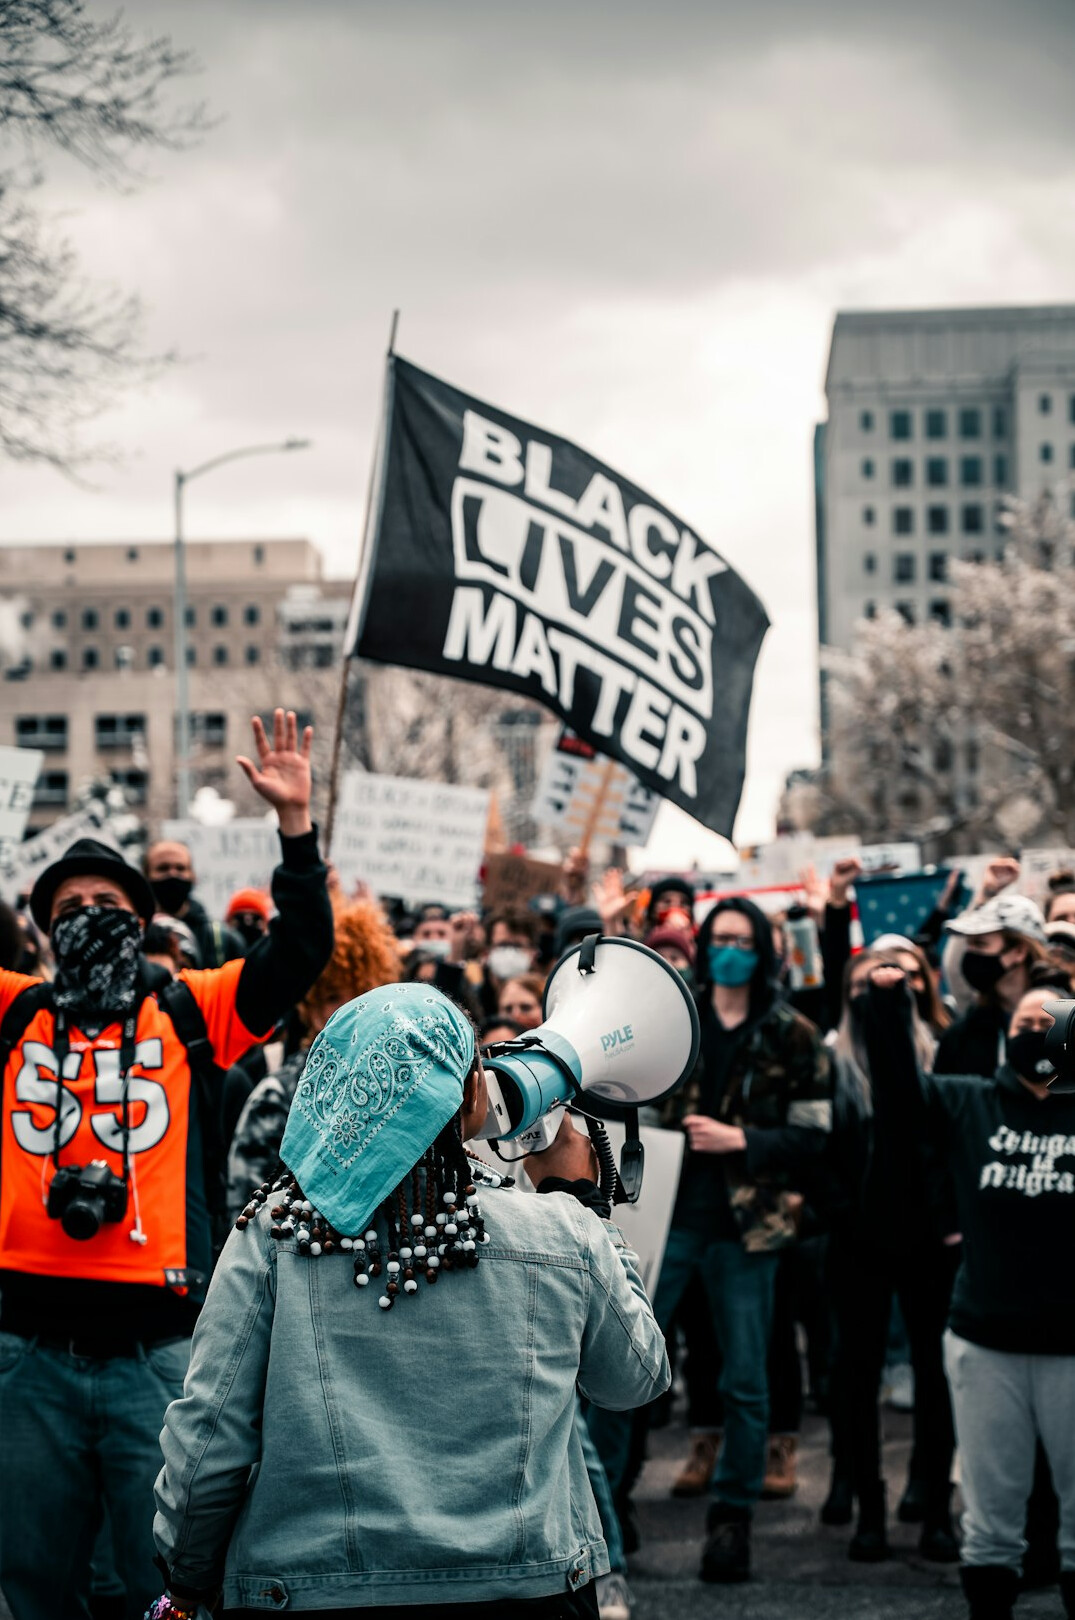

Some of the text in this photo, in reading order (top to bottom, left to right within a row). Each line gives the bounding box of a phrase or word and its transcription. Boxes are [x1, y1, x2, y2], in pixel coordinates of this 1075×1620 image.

[459, 409, 728, 625] BLACK
[461, 493, 705, 692] LIVES
[443, 586, 707, 798] MATTER
[11, 1038, 170, 1155] 55
